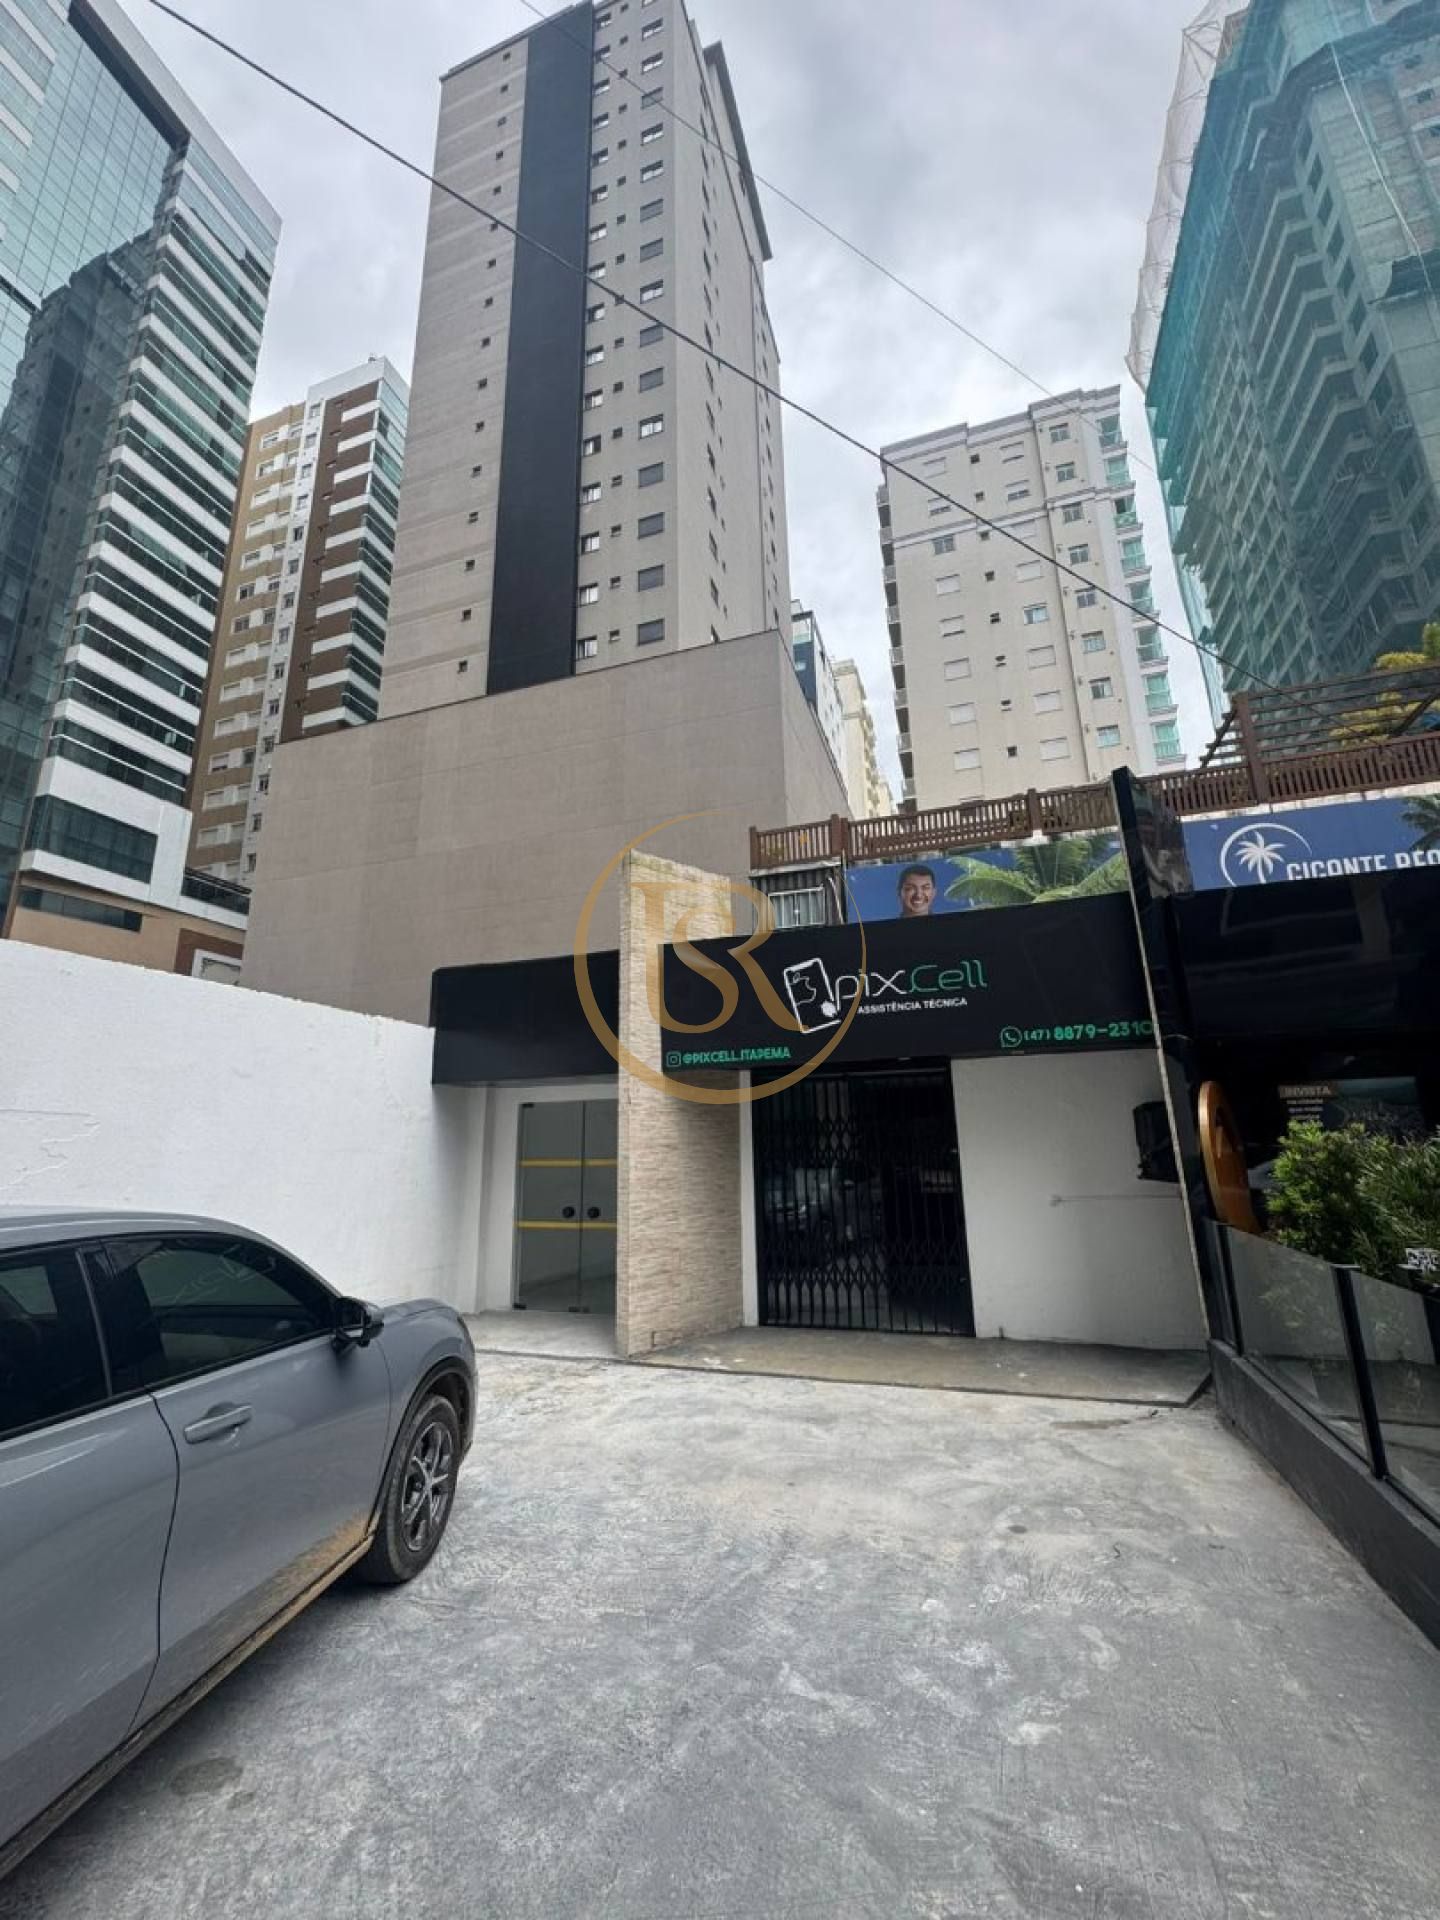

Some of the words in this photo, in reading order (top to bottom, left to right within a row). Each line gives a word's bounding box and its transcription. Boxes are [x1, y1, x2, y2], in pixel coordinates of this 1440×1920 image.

[858, 1000, 922, 1015] ASSISTÊNCIA
[923, 996, 968, 1010] TÉCNICA
[1023, 1028, 1051, 1041] (47)
